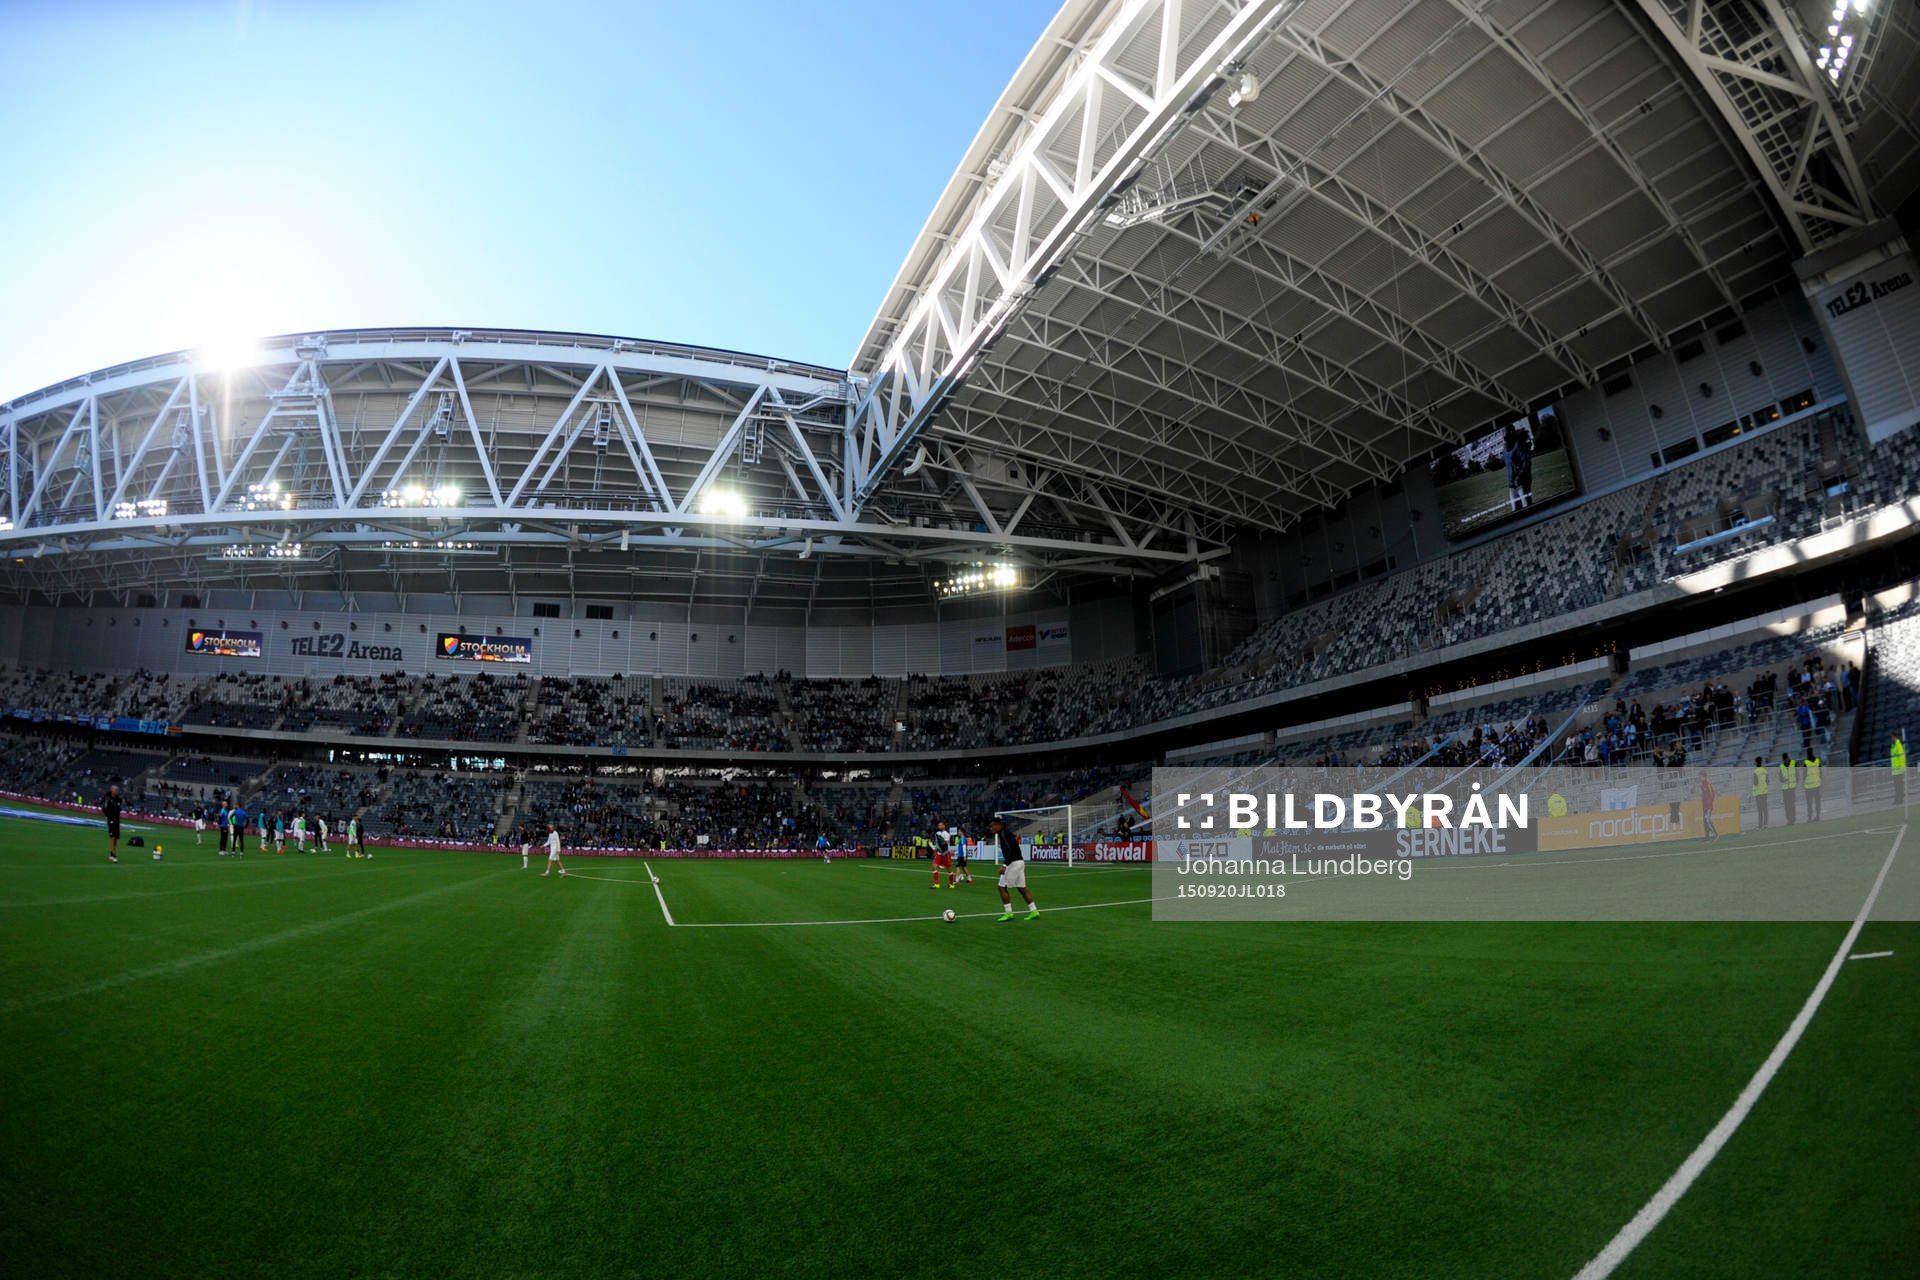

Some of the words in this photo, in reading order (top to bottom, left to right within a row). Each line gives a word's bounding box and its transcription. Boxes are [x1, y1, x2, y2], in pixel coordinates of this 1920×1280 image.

[1826, 281, 1872, 318] TELE2
[1870, 272, 1912, 299] Arena
[204, 636, 257, 649] STOCKHOLM
[291, 633, 345, 658] TELE2
[347, 641, 403, 661] Arena
[460, 642, 525, 654] STOCKHOLM
[1396, 822, 1506, 858] SERNEKE
[1031, 845, 1061, 860] Prioritet
[1095, 841, 1146, 861] Stavdal
[1188, 842, 1229, 858] EIZO
